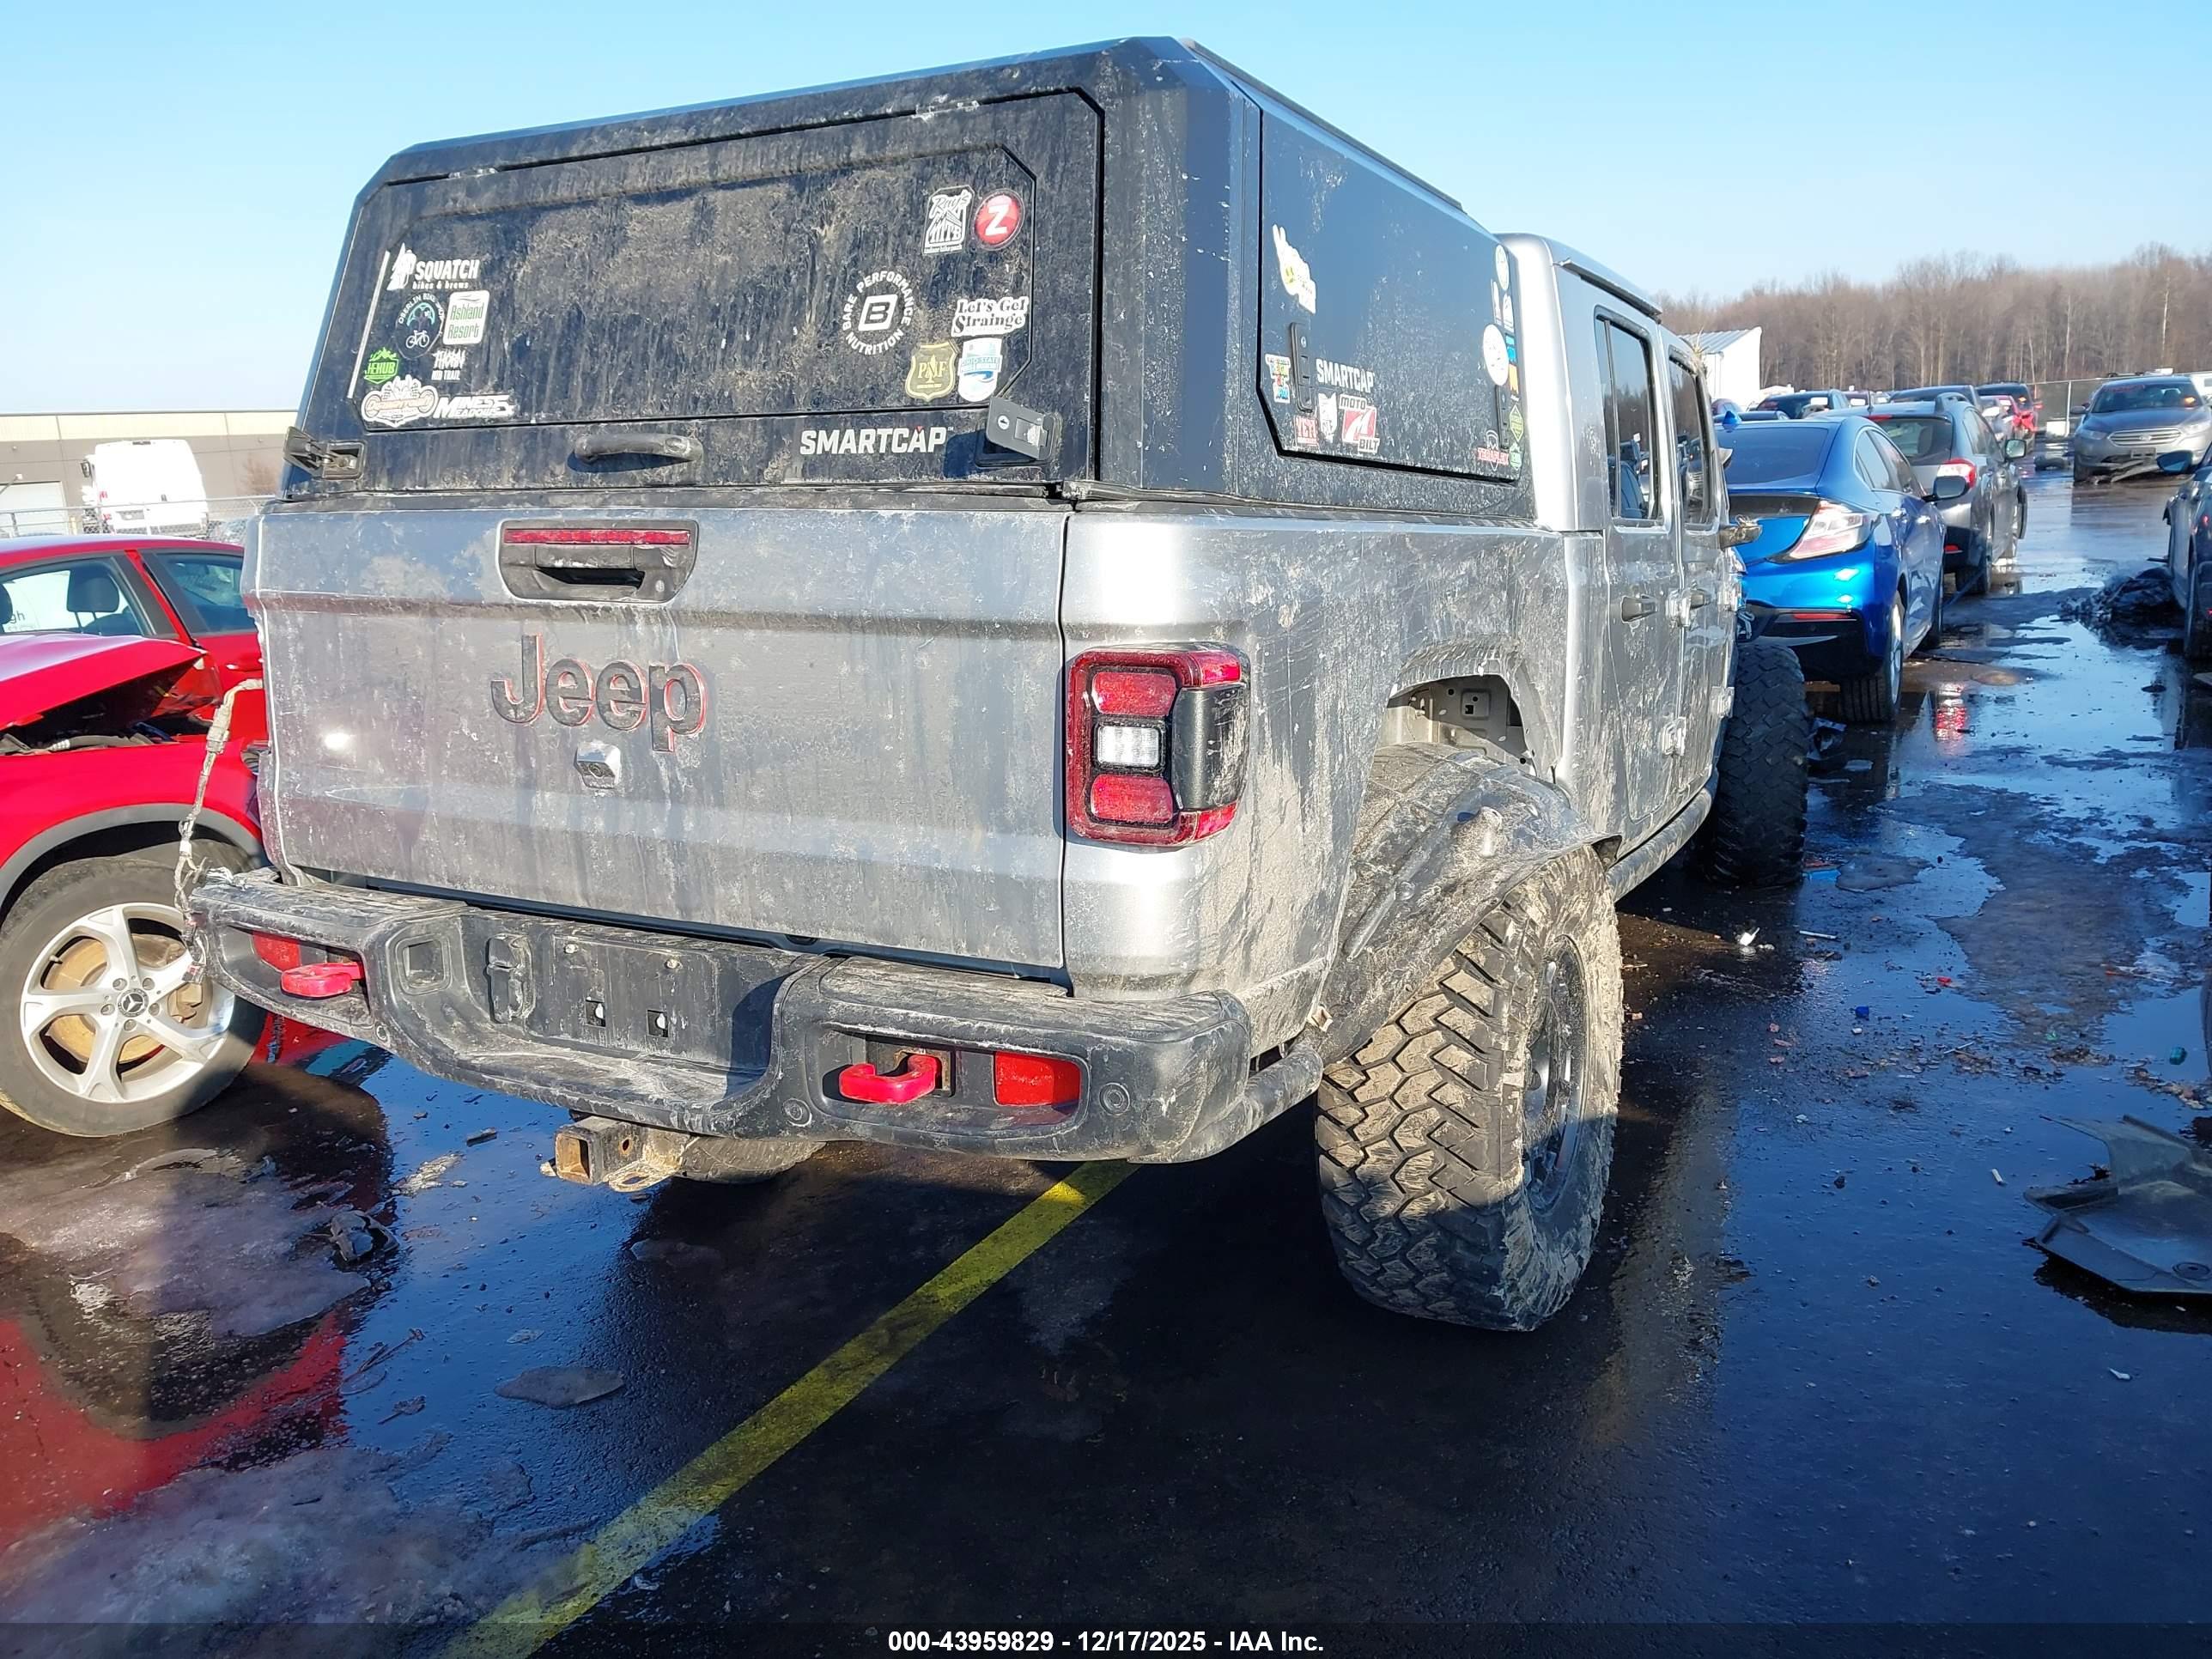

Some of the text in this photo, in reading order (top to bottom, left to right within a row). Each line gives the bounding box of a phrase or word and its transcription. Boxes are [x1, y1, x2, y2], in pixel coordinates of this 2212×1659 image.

[985, 205, 1010, 235] Z
[415, 259, 480, 282] SQUATCH
[398, 295, 422, 324] OBERLIN
[450, 302, 484, 320] Ashland
[842, 270, 914, 355] BARE PERFORMANCE NUTRITION
[958, 297, 1024, 313] Let's Get
[447, 325, 479, 338] Resort
[1316, 358, 1375, 393] SMARTCAP
[1340, 397, 1366, 410] MOTO
[799, 426, 947, 455] SMARTCAP
[1359, 440, 1379, 451] BILT
[490, 633, 708, 752] Jeep
